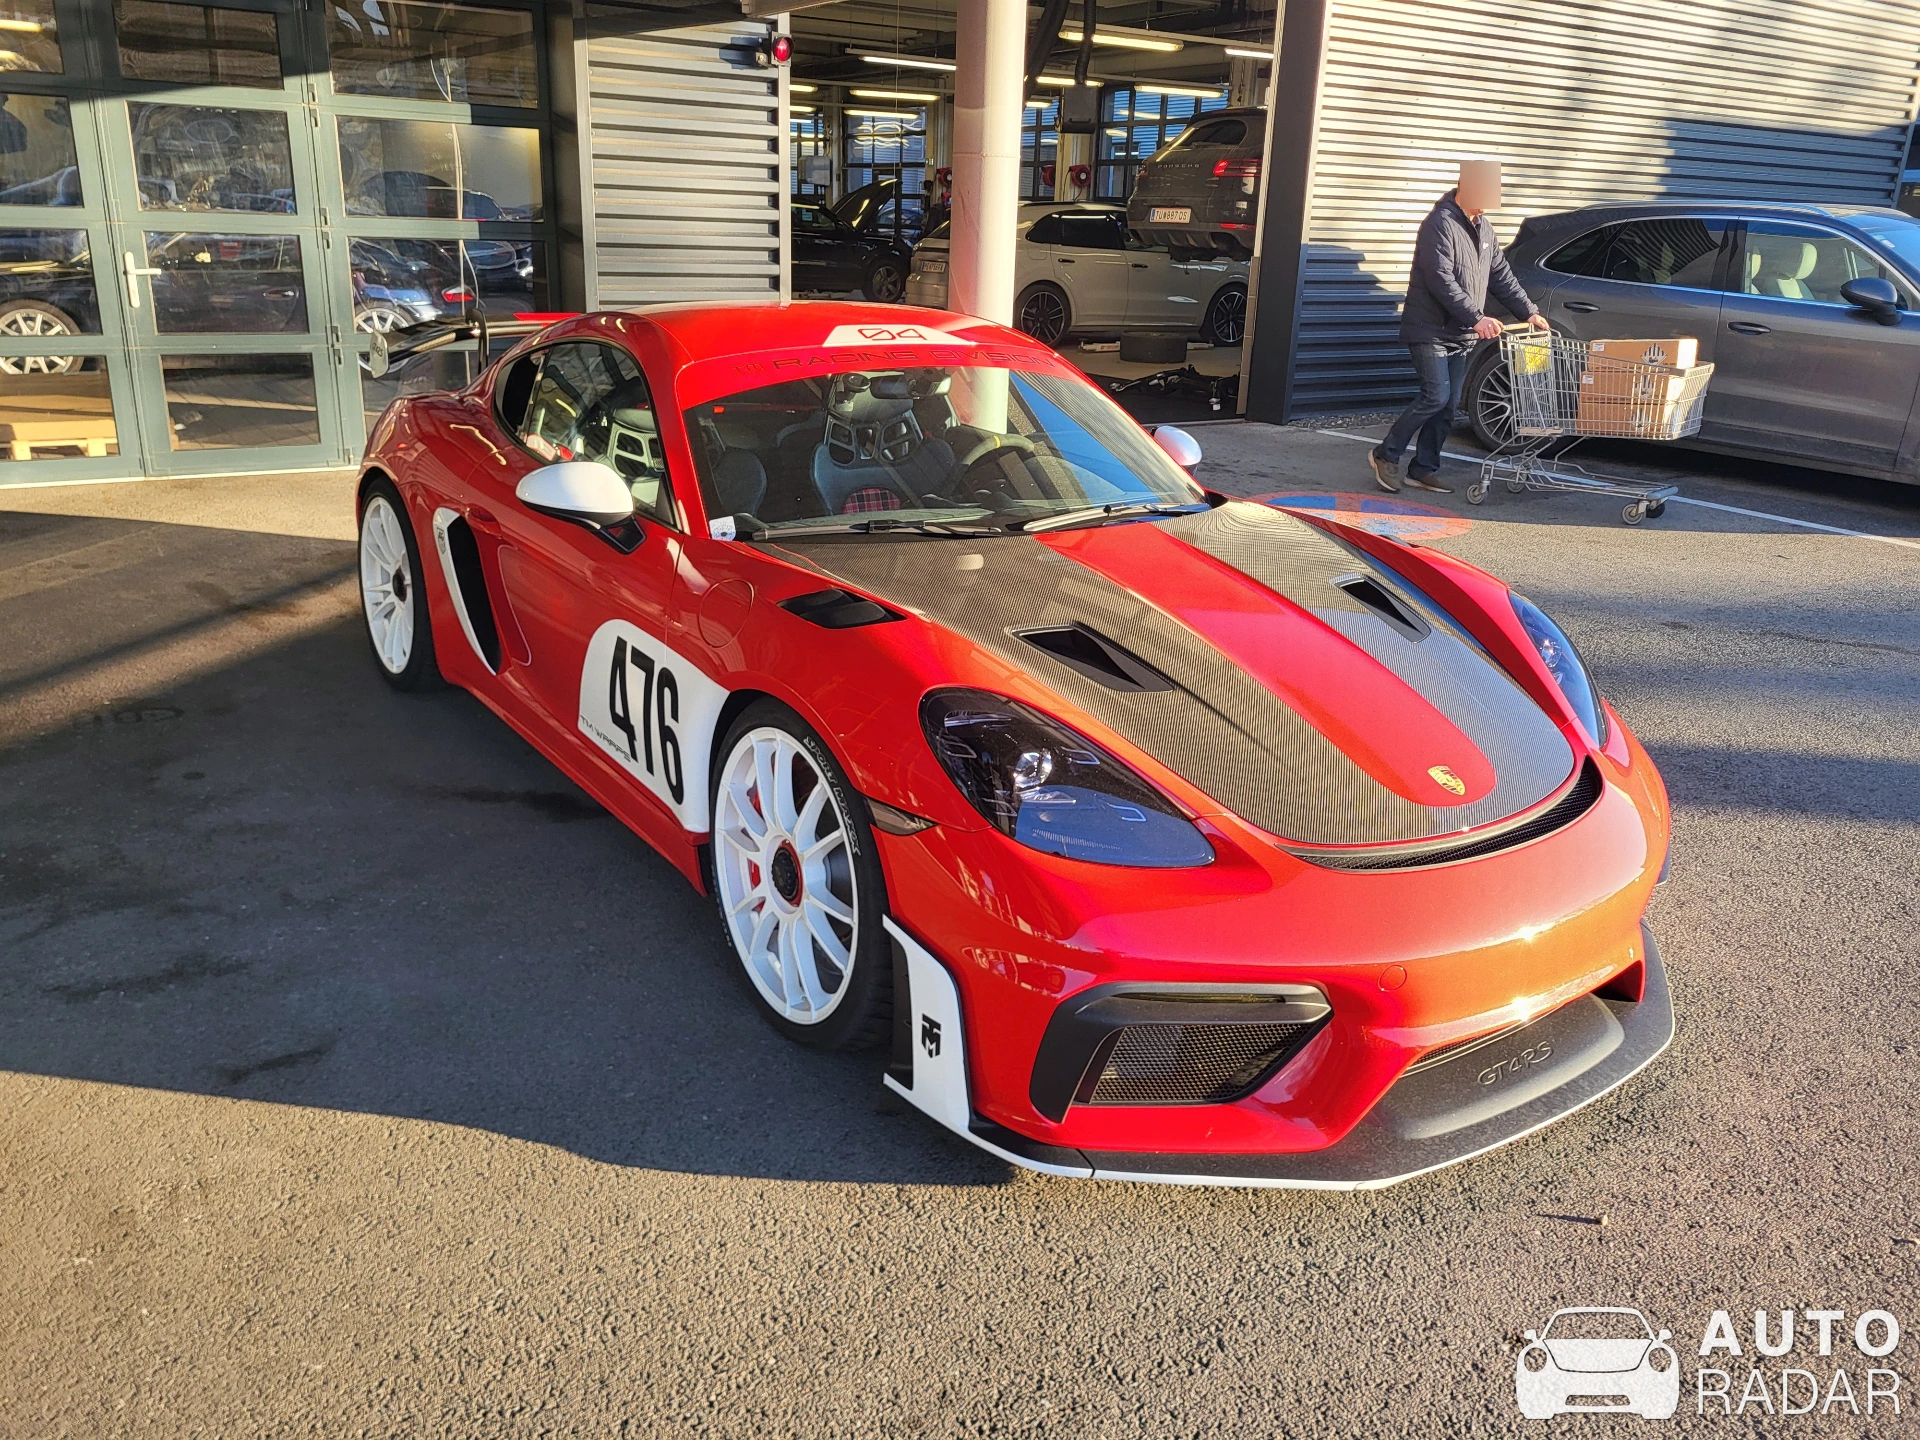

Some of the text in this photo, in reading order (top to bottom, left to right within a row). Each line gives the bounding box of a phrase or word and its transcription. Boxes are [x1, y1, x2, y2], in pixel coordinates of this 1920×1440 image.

[857, 328, 928, 341] 04
[772, 351, 918, 370] RACING
[930, 351, 1056, 368] DIVISION
[580, 714, 594, 732] TM
[609, 635, 684, 806] 476
[803, 736, 862, 856] SPORT MAXX
[1477, 1041, 1554, 1085] GT4RS
